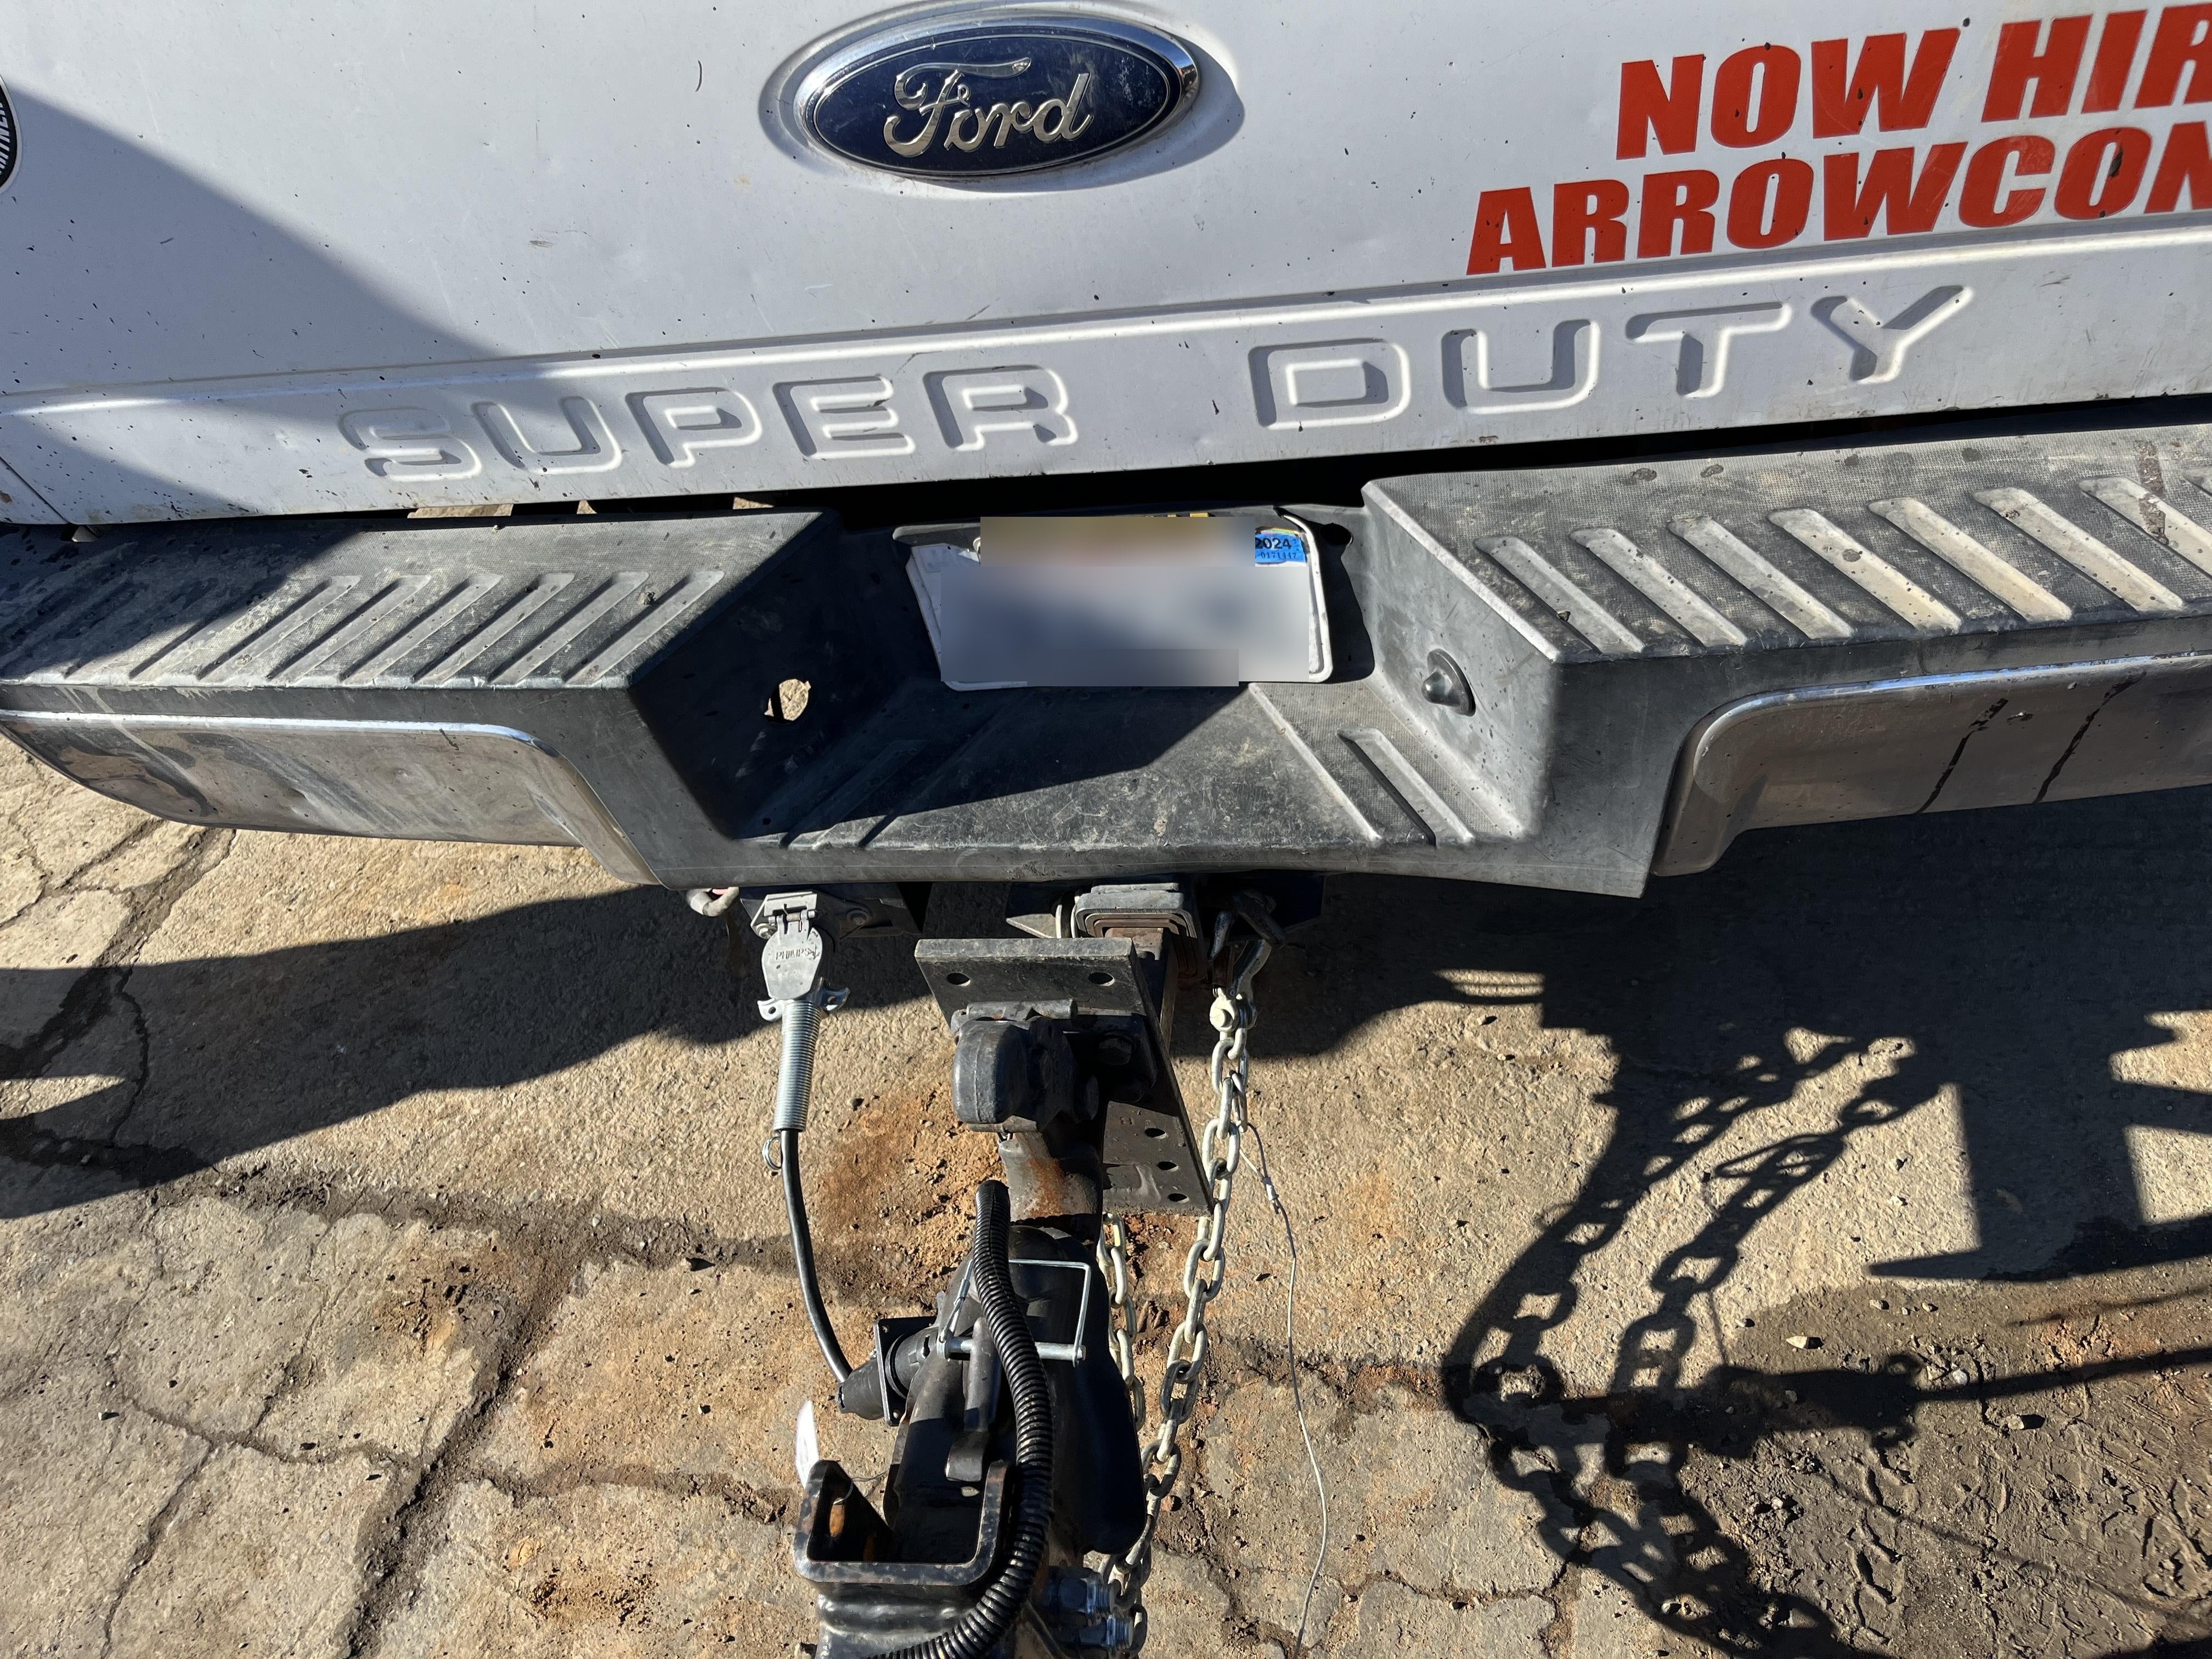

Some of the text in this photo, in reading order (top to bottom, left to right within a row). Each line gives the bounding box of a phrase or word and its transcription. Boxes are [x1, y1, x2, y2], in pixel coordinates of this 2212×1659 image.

[883, 57, 1095, 157] Ford
[1616, 2, 2212, 160] NOW HIR
[338, 284, 1974, 483] SUPER DUTY
[1255, 537, 1292, 549] 2024
